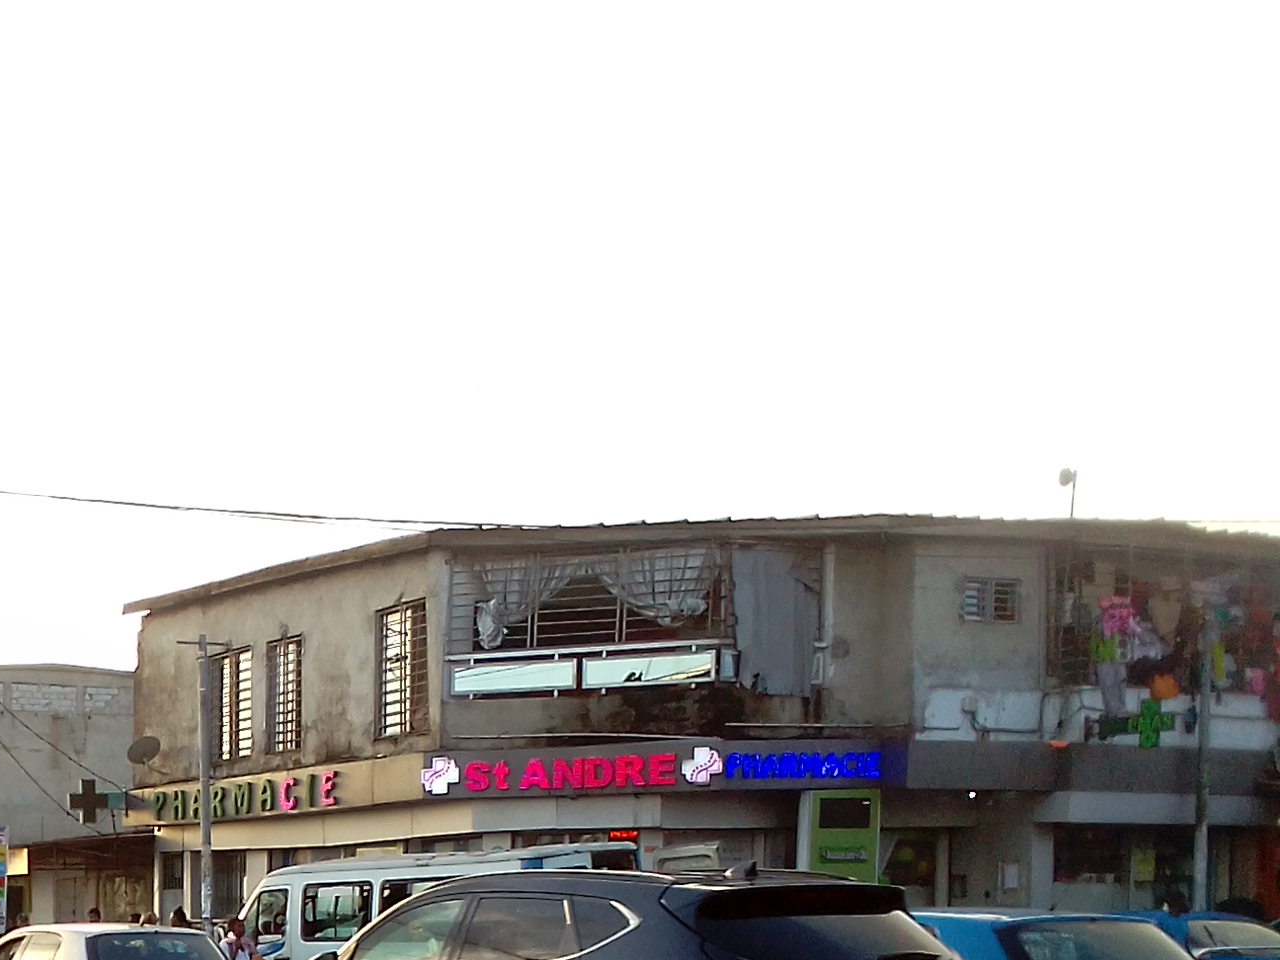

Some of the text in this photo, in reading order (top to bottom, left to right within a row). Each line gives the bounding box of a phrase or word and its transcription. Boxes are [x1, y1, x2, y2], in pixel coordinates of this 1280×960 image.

[464, 753, 677, 792] St ANDRE
[725, 752, 882, 780] PHARMACIE
[153, 770, 337, 820] PHARMACIE
